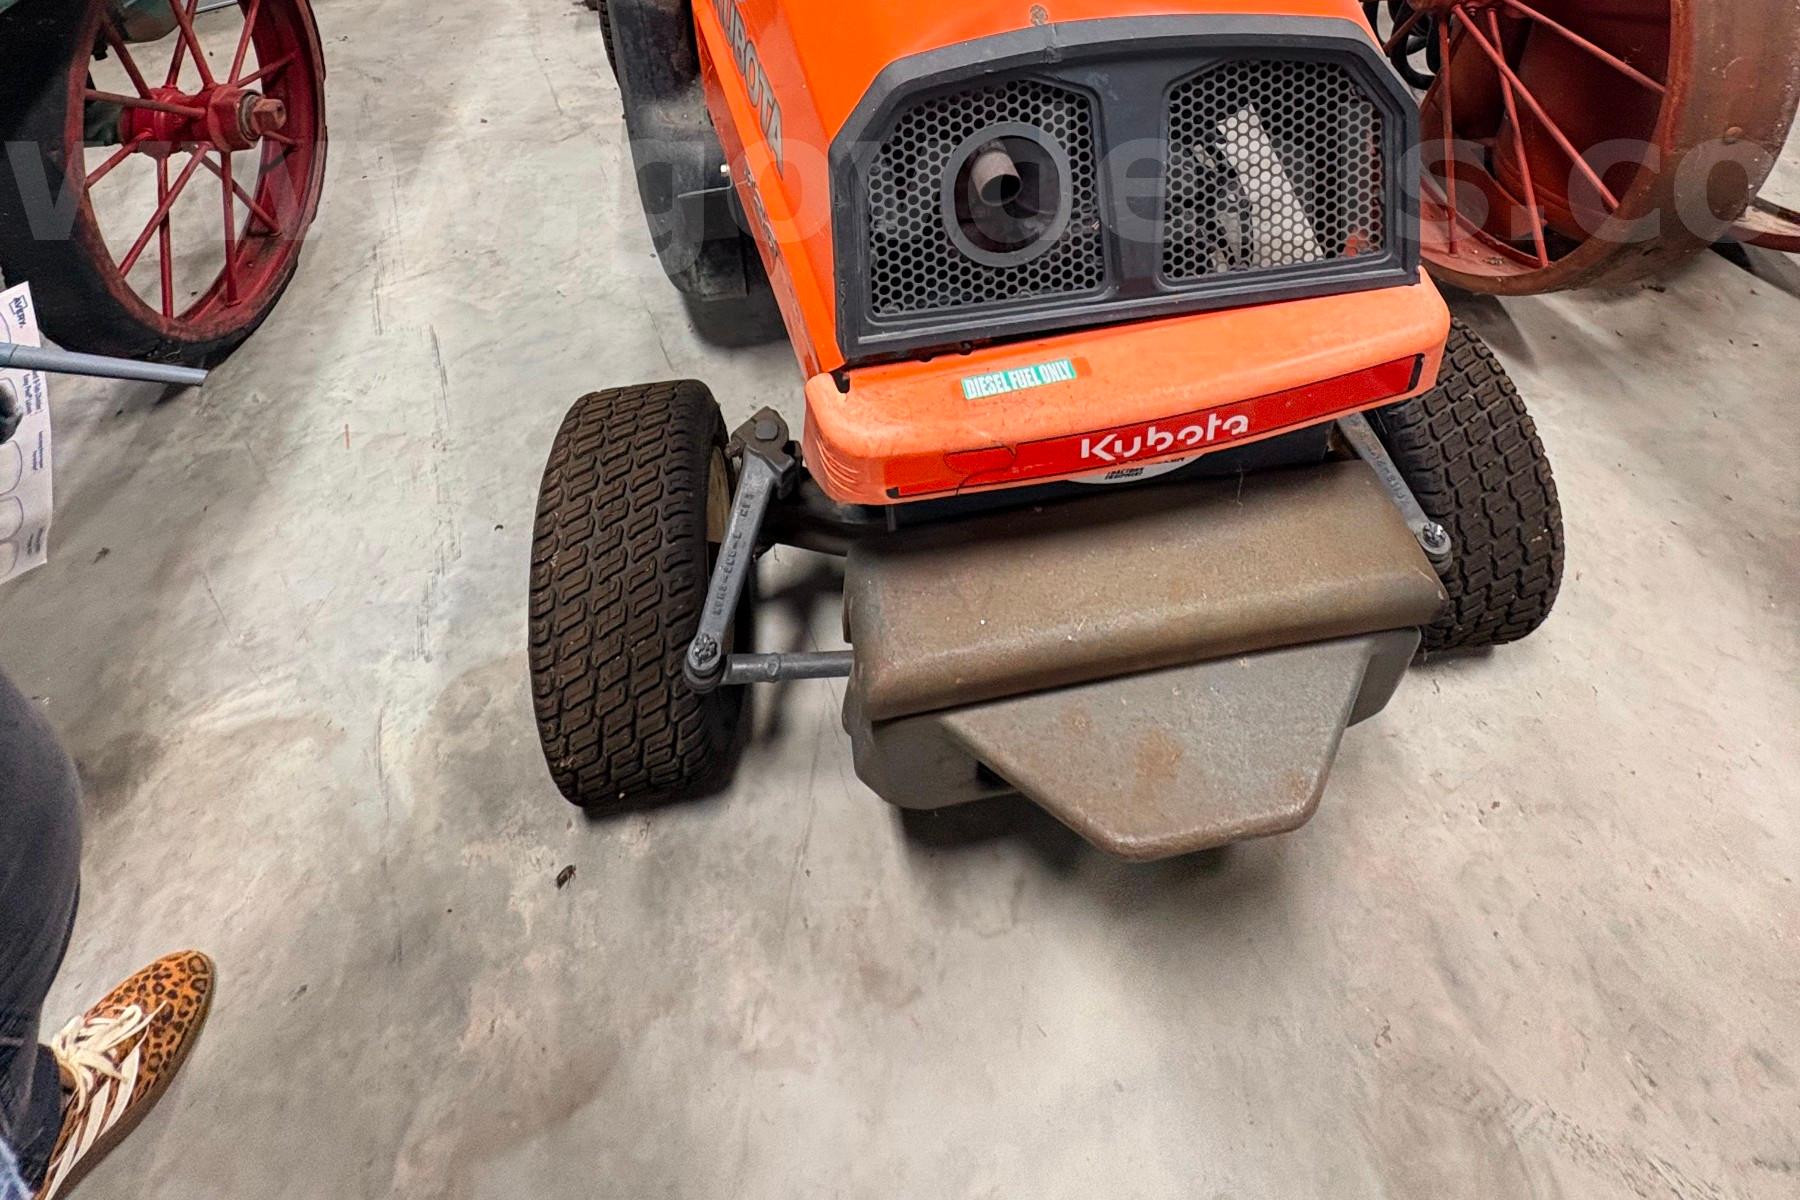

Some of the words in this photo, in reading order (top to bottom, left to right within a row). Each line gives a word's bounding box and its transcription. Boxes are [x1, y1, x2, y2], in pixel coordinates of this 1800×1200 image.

[964, 371, 1012, 399] DIESEL
[1007, 366, 1042, 391] FUEL
[1038, 359, 1073, 384] ONLY
[1080, 412, 1249, 462] Kubota
